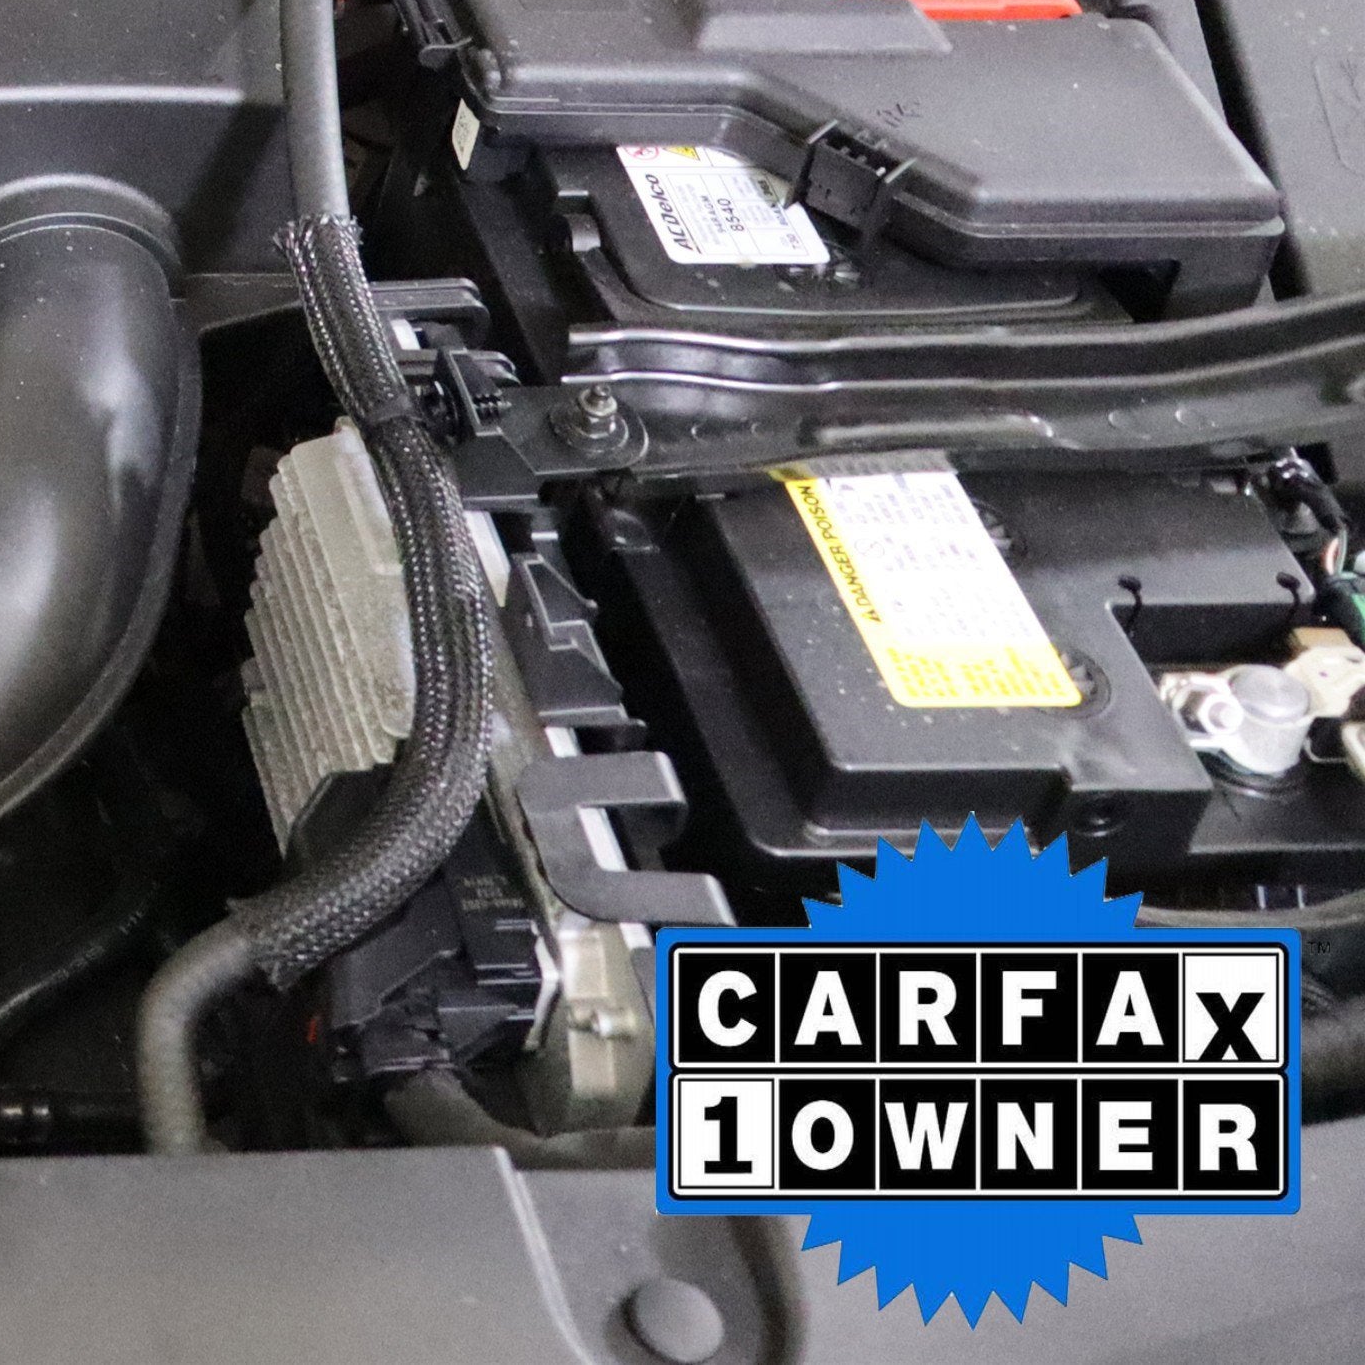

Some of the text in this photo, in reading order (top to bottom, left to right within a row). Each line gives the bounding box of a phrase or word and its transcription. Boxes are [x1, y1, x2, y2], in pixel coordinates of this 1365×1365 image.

[645, 173, 693, 251] ACDelco
[717, 198, 745, 232] 8540
[798, 485, 870, 606] DANGER POISON
